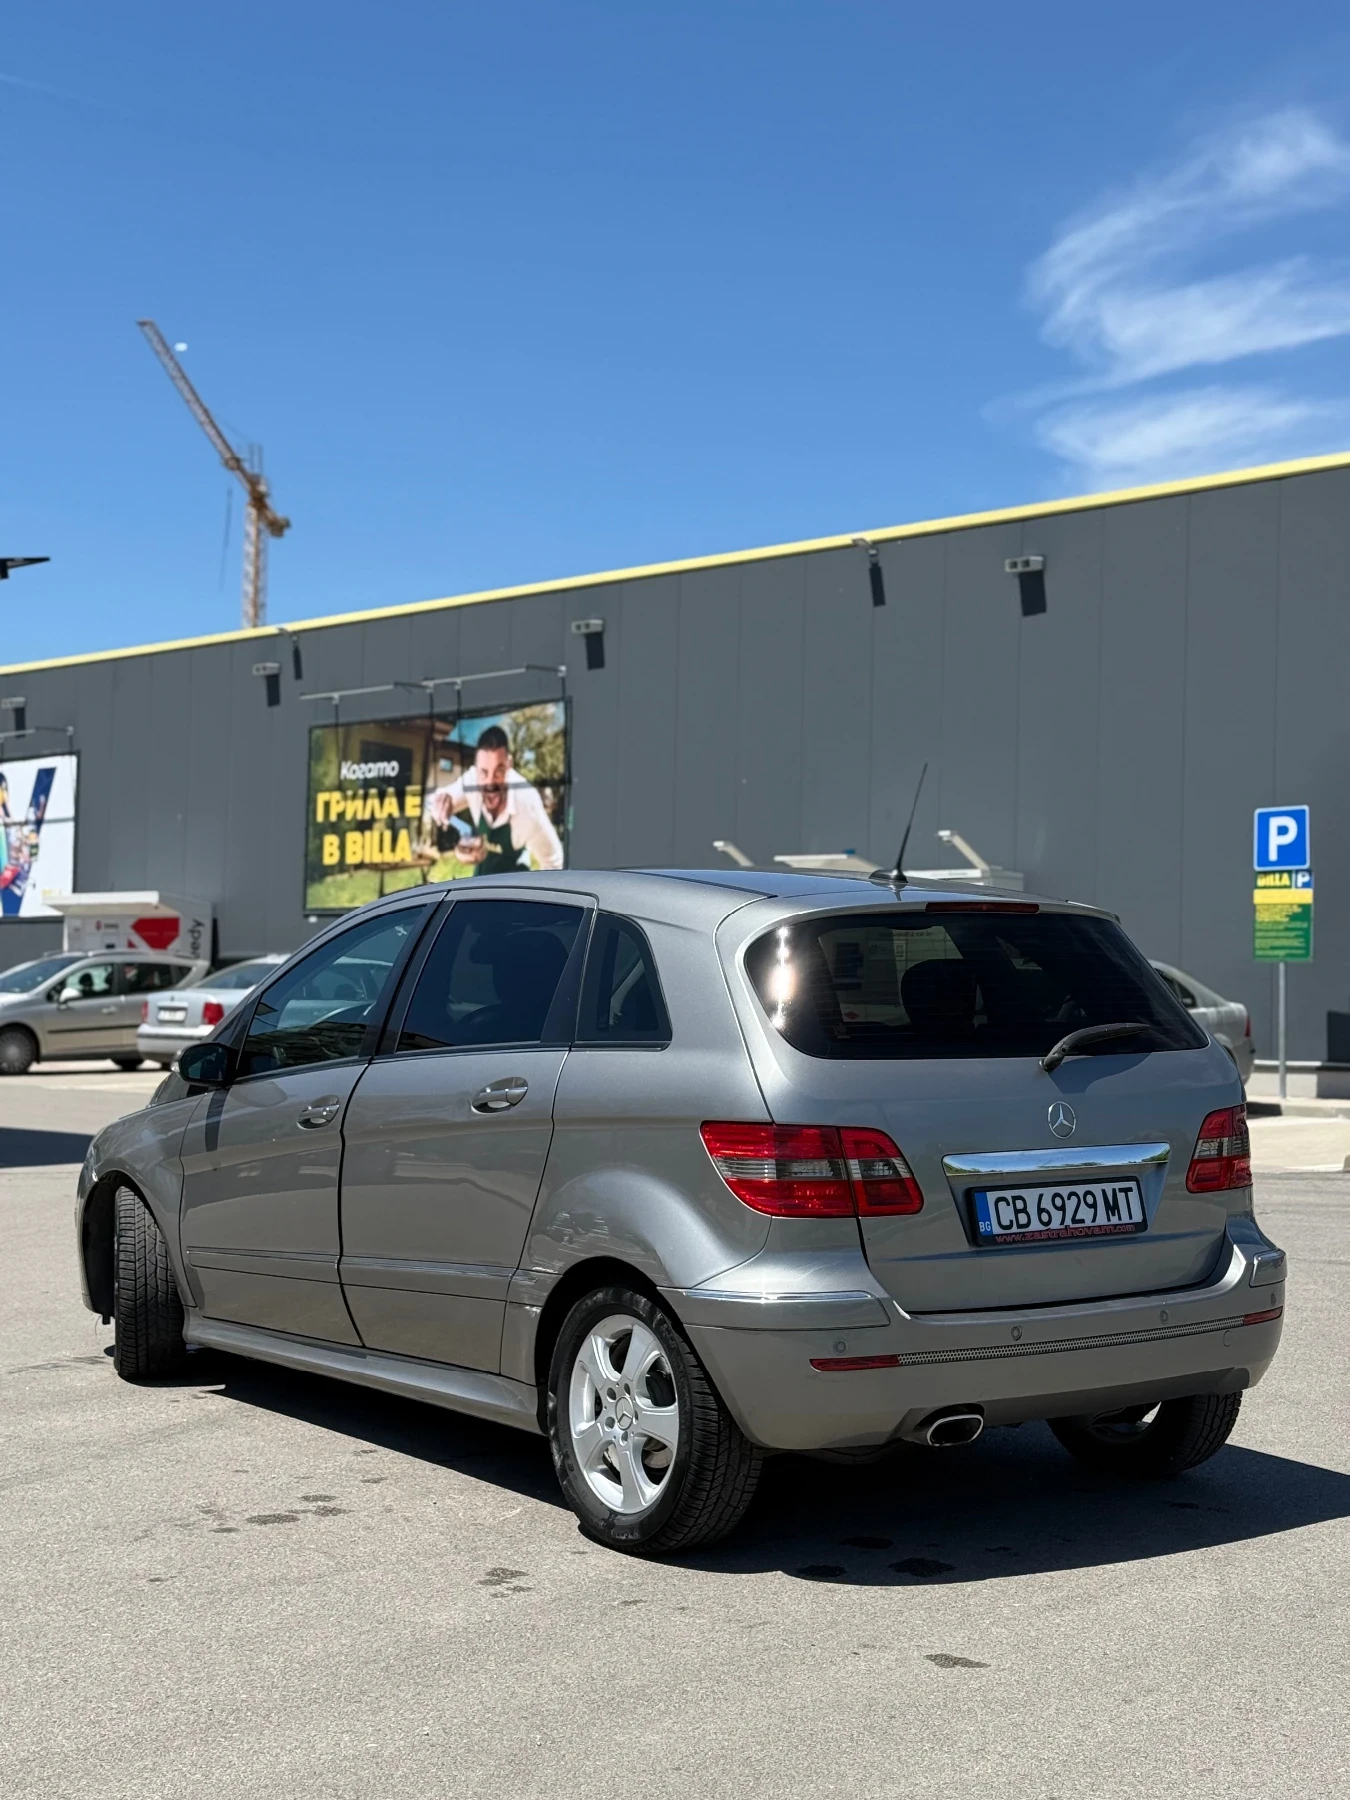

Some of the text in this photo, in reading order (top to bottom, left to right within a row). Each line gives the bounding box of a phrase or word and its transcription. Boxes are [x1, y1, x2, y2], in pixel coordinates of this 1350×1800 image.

[340, 761, 399, 779] Когато
[316, 786, 400, 822] ГРИЛА
[345, 828, 413, 865] BILLA
[1269, 815, 1297, 862] P
[1297, 871, 1310, 887] P
[979, 1221, 991, 1232] BG
[994, 1187, 1133, 1230] CB 6929 MT
